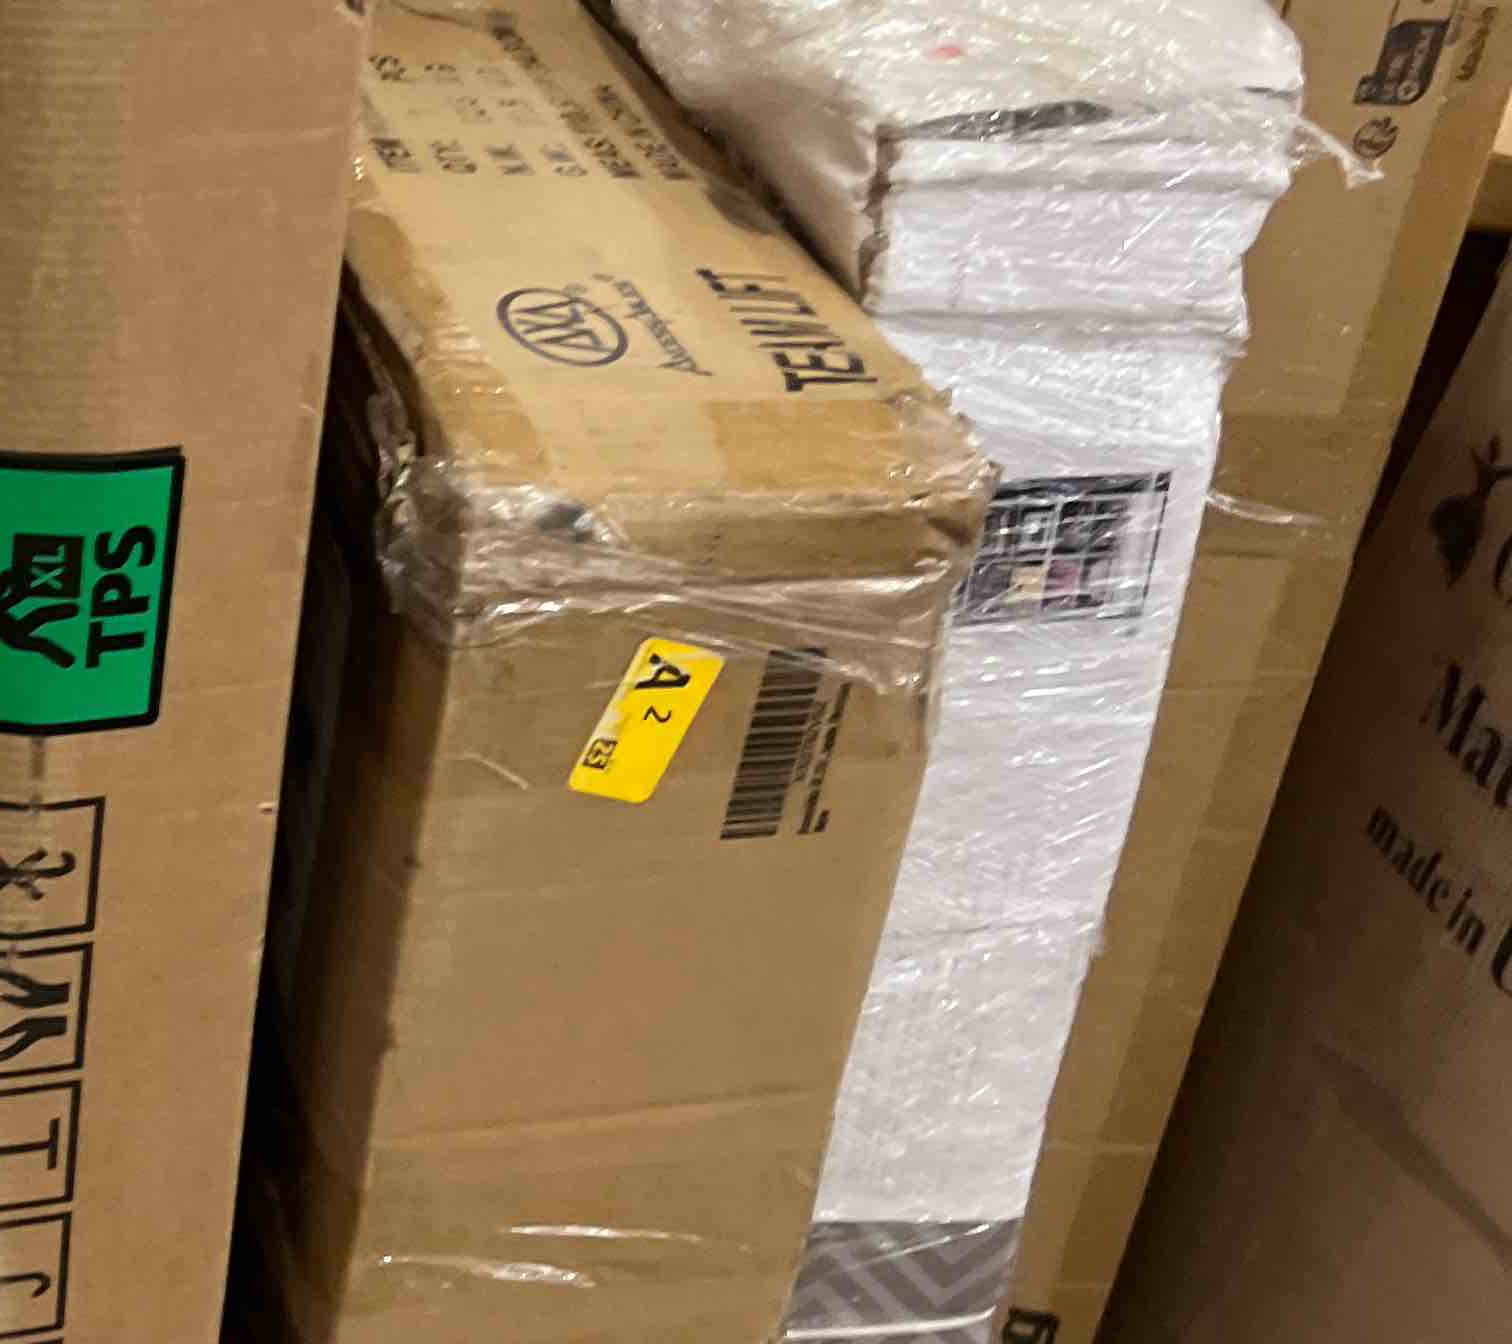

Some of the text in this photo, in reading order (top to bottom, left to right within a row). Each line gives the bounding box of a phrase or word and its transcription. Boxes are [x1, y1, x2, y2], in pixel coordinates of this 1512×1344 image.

[30, 543, 79, 592] XL
[85, 525, 156, 668] TPS
[634, 653, 691, 690] A
[1364, 804, 1486, 958] made in
